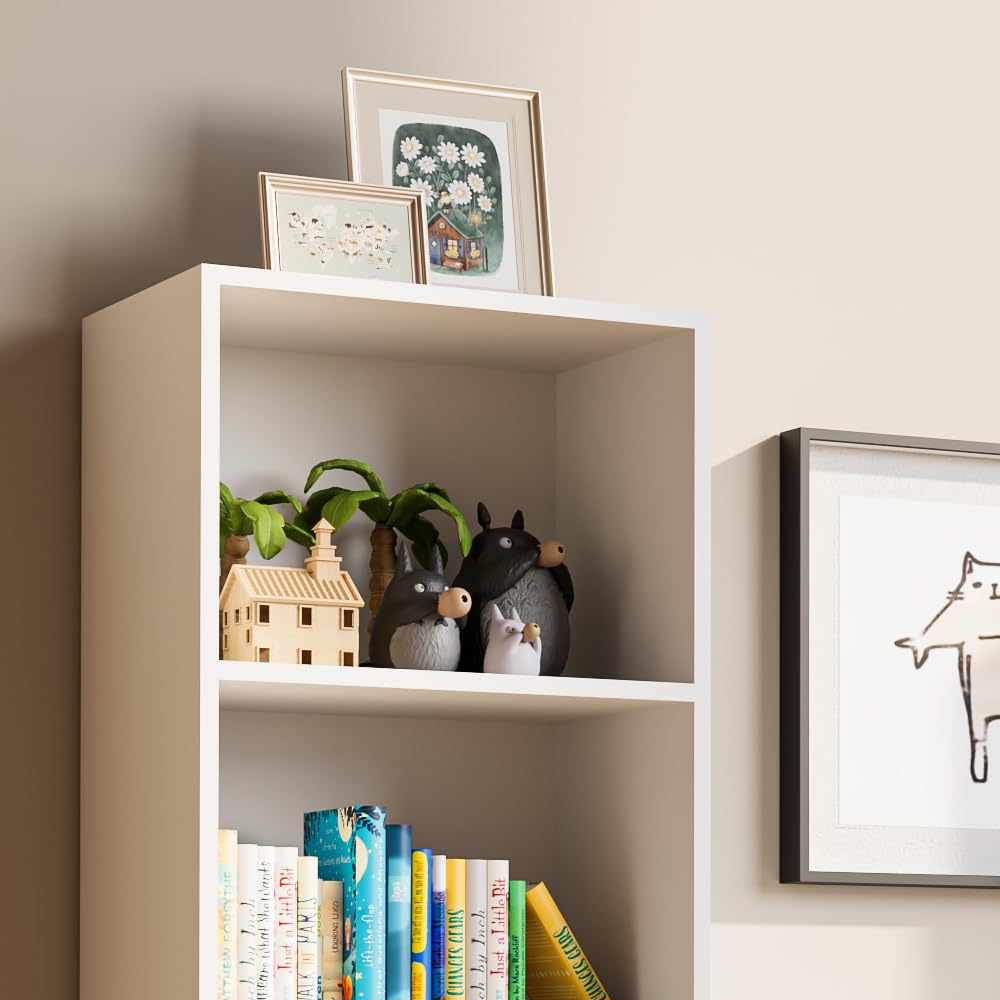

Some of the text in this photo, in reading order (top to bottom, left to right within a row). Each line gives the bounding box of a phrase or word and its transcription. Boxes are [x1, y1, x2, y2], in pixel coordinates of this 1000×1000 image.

[375, 836, 383, 883] Answers
[375, 887, 383, 906] and
[239, 897, 256, 937] Inch
[297, 896, 318, 944] PARIS
[471, 909, 486, 946] Inch
[361, 904, 375, 967] Lift-the-flap
[375, 910, 383, 965] Questions
[512, 934, 520, 963] Rockliff
[552, 925, 581, 960] GEARS
[239, 946, 258, 966] by
[277, 944, 293, 974] Just
[301, 953, 313, 965] IN
[446, 909, 464, 996] CHANGES GEARS
[470, 954, 488, 973] by
[489, 950, 505, 979] Just
[497, 937, 505, 945] a
[375, 968, 383, 995] First
[512, 964, 520, 983] Mara
[513, 985, 521, 994] by
